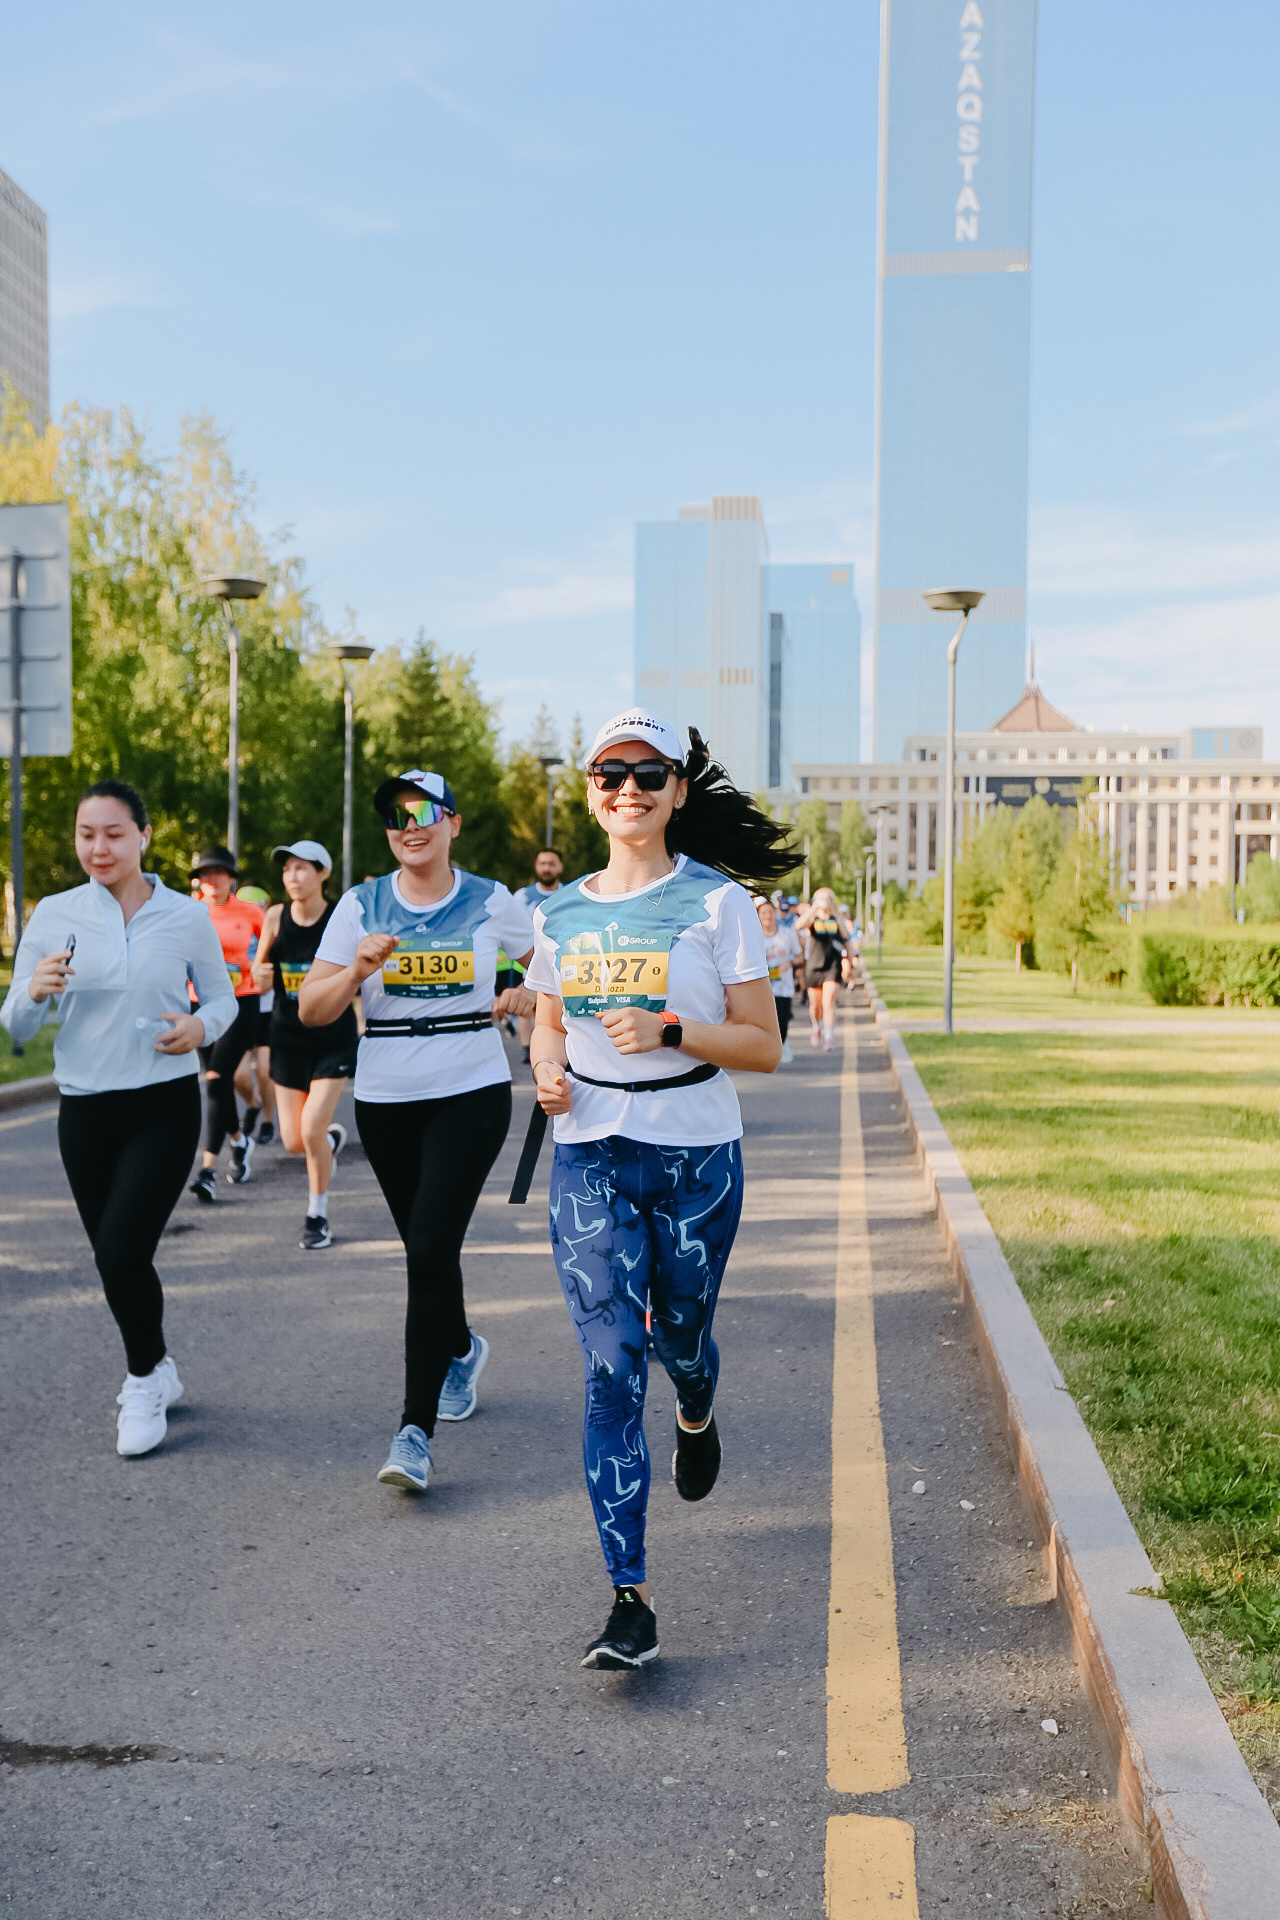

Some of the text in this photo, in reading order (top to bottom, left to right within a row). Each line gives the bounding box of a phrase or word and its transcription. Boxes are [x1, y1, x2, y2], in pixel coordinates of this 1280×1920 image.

[955, 0, 985, 241] AZAQSTAN
[630, 937, 658, 945] GROUP
[399, 955, 458, 975] 3130
[615, 996, 631, 1004] VISA
